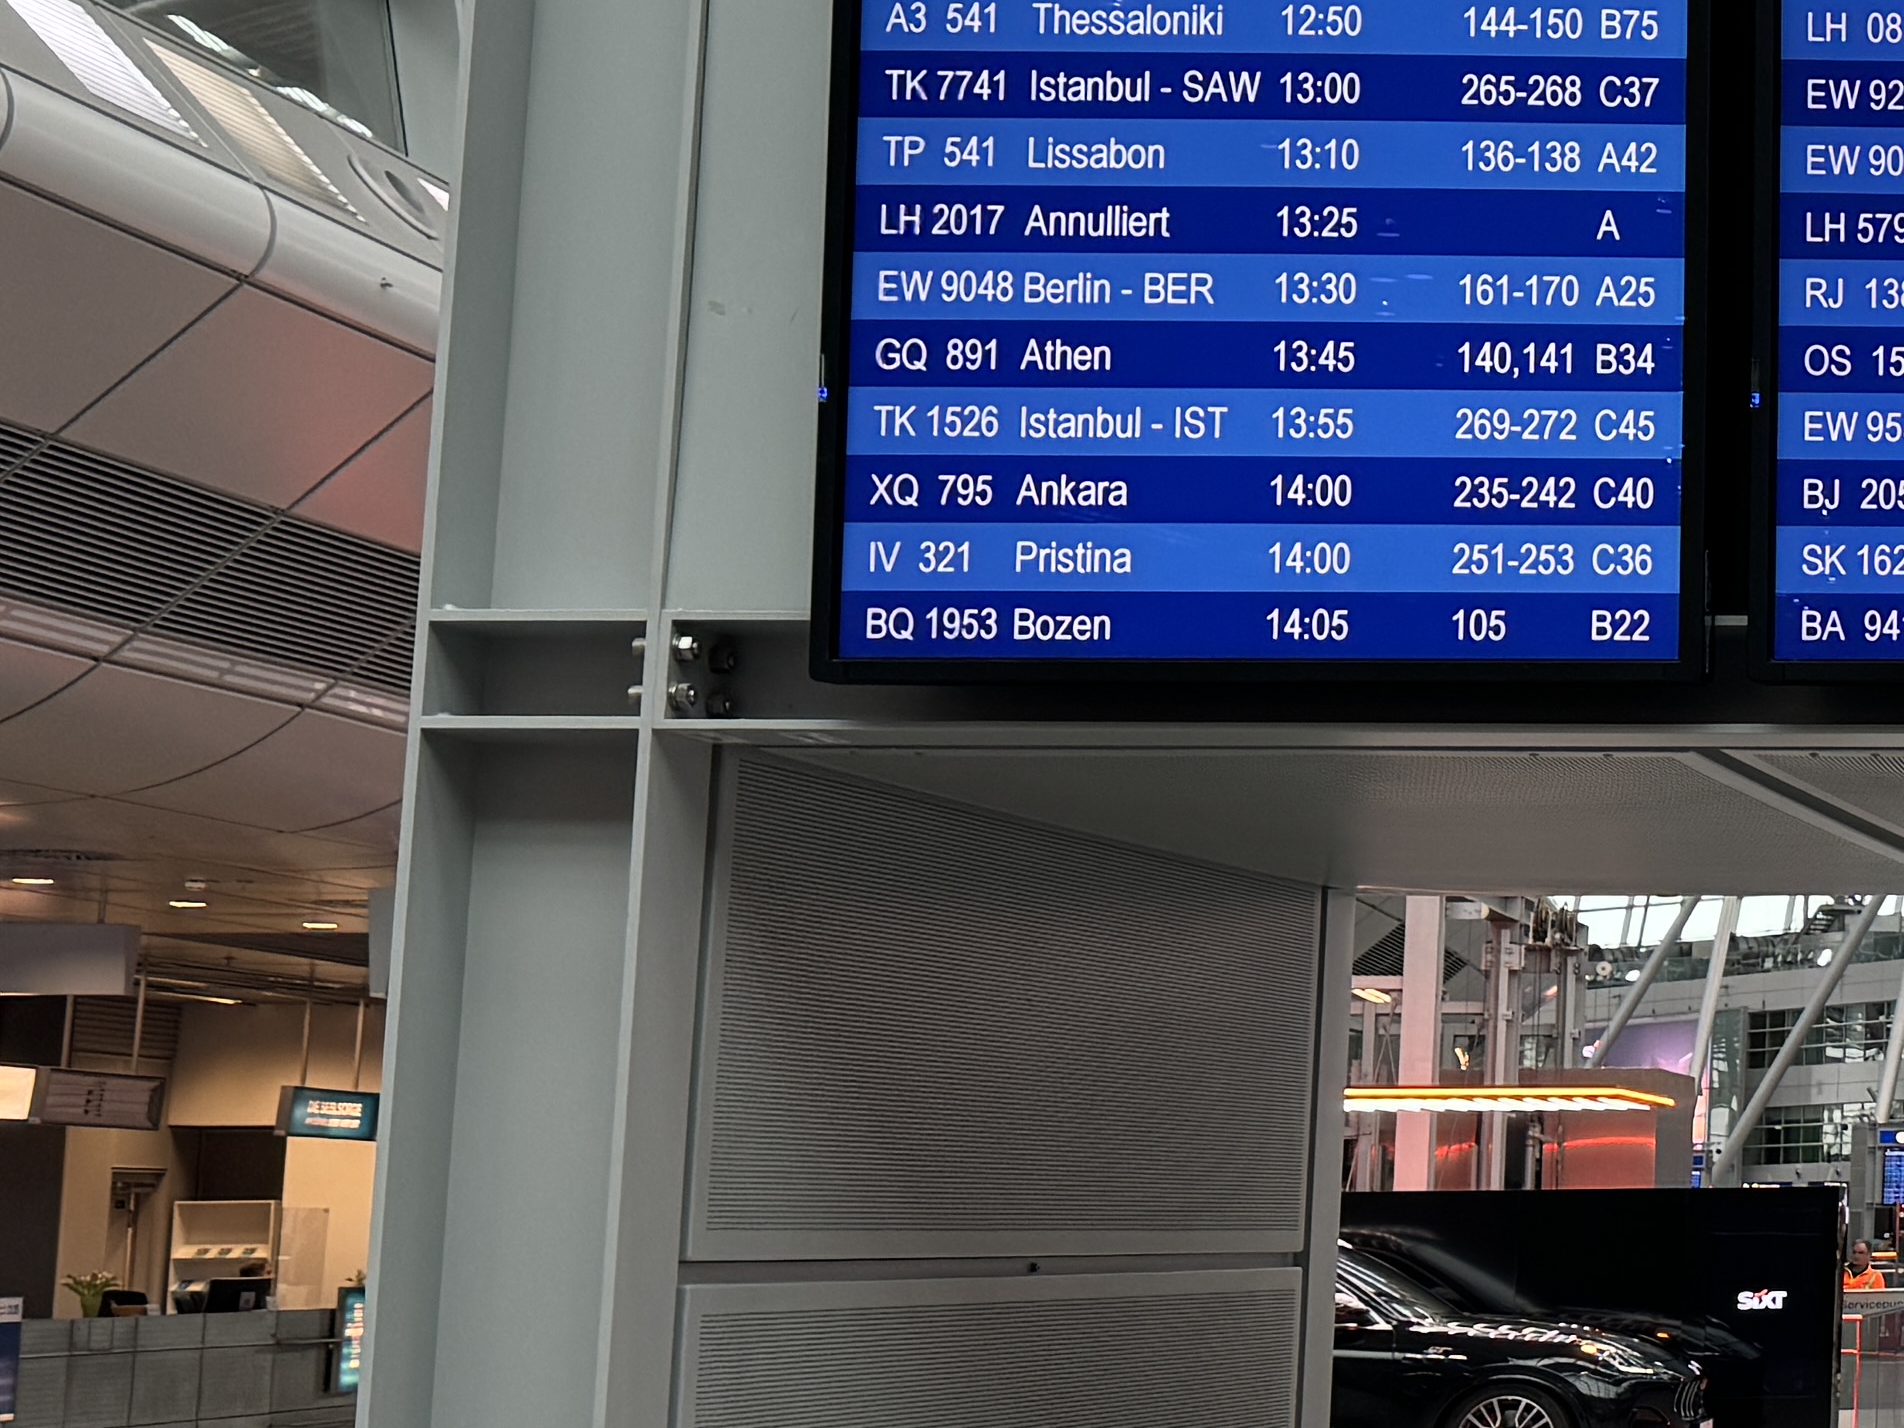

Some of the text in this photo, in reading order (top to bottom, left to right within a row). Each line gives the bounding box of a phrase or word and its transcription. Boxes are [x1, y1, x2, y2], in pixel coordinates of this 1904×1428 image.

[1806, 211, 1846, 243] LH
[866, 607, 1650, 641] BQ 1953 Bozen 14:05 105 B22
